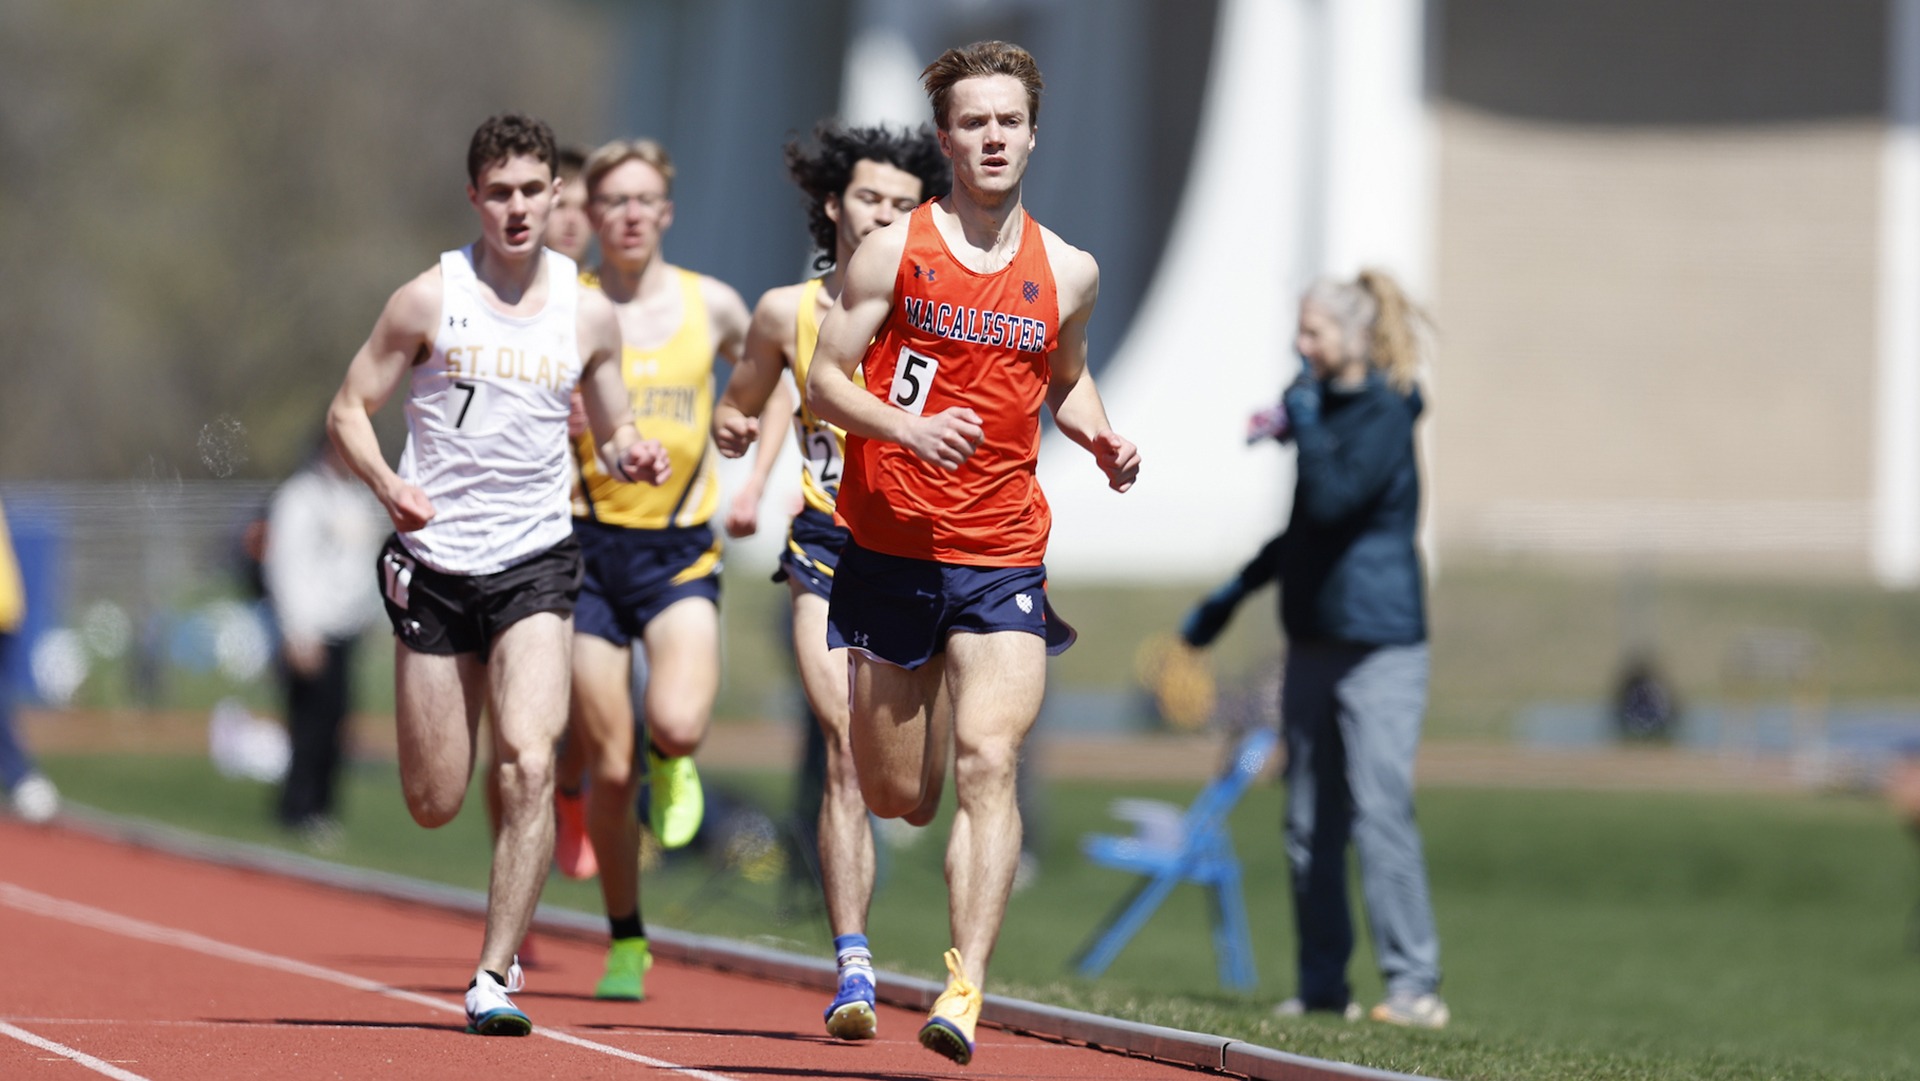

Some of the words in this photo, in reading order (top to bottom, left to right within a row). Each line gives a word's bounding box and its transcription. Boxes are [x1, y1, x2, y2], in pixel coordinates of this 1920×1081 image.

[905, 297, 1046, 353] MACALESTER
[445, 346, 486, 379] ST.
[496, 347, 569, 394] OLAF
[896, 354, 928, 406] 5
[454, 381, 475, 429] 7
[628, 385, 699, 427] LETON
